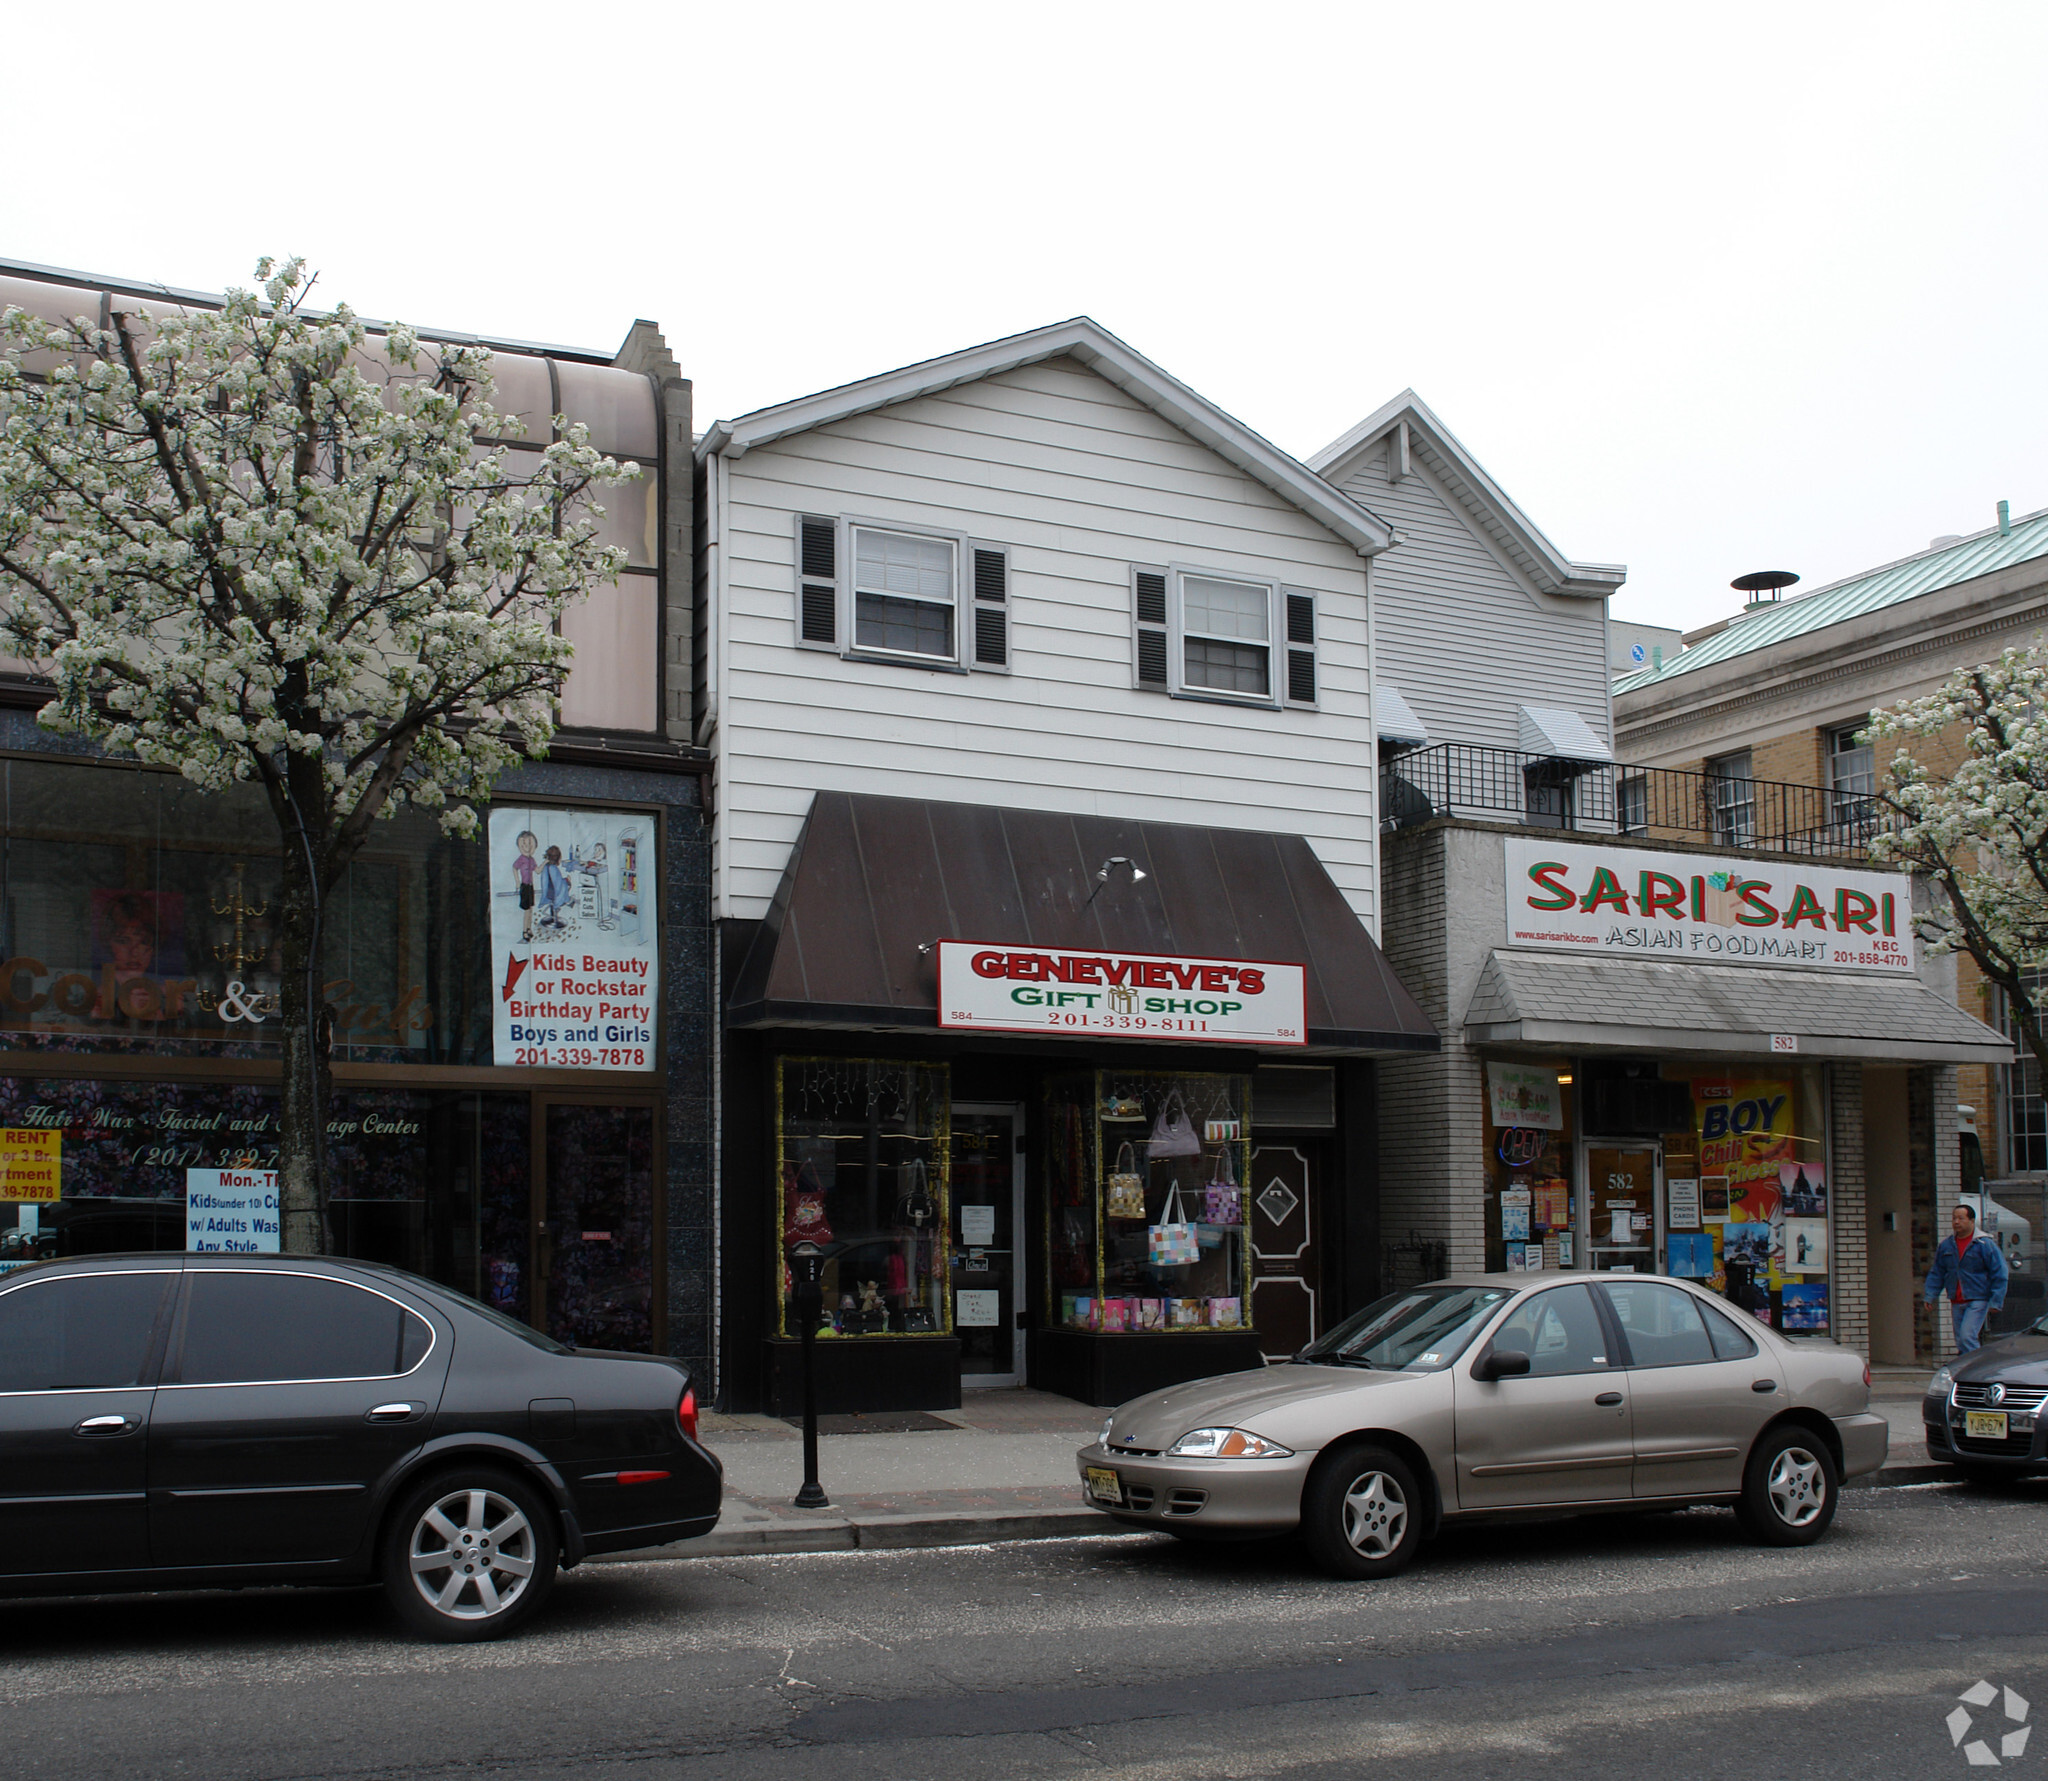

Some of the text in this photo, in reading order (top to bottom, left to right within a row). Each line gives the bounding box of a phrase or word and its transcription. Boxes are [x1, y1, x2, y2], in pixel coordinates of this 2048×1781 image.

[1526, 861, 1896, 938] SARI SARI
[1514, 926, 1827, 960] www.sarisarikbc.com ASIAN FOODMART
[1872, 940, 1900, 952] KBC
[533, 954, 649, 977] Kids Beauty
[1833, 950, 1909, 967] 201-858-4770
[970, 951, 1266, 995] GENEVIEVE'S
[0, 956, 198, 1021] Color
[217, 980, 268, 1024] &
[535, 978, 648, 996] or Rockstar
[510, 1000, 650, 1024] Birthday Party
[1010, 986, 1243, 1016] GIFT SHOP
[510, 1024, 651, 1046] Boys and Girls
[950, 1010, 1297, 1038] 584 201-339-8111 584
[1774, 1036, 1793, 1050] 582
[514, 1048, 645, 1066] 201-339-7878
[20, 1104, 74, 1128] Hair
[91, 1107, 136, 1130] Wax
[156, 1108, 224, 1131] Facial
[229, 1113, 272, 1132] and
[362, 1112, 422, 1135] Center
[1701, 1094, 1787, 1141] BOY
[5, 1131, 50, 1145] RENT
[1502, 1128, 1544, 1158] OPEN
[21, 1151, 29, 1162] 3
[35, 1151, 53, 1162] Br.
[131, 1144, 280, 1169] (201) 339-7
[1701, 1138, 1743, 1166] Chili
[1607, 1173, 1635, 1190] 582
[264, 1195, 280, 1209] Cu
[207, 1217, 248, 1233] Adults
[252, 1218, 279, 1234] Was
